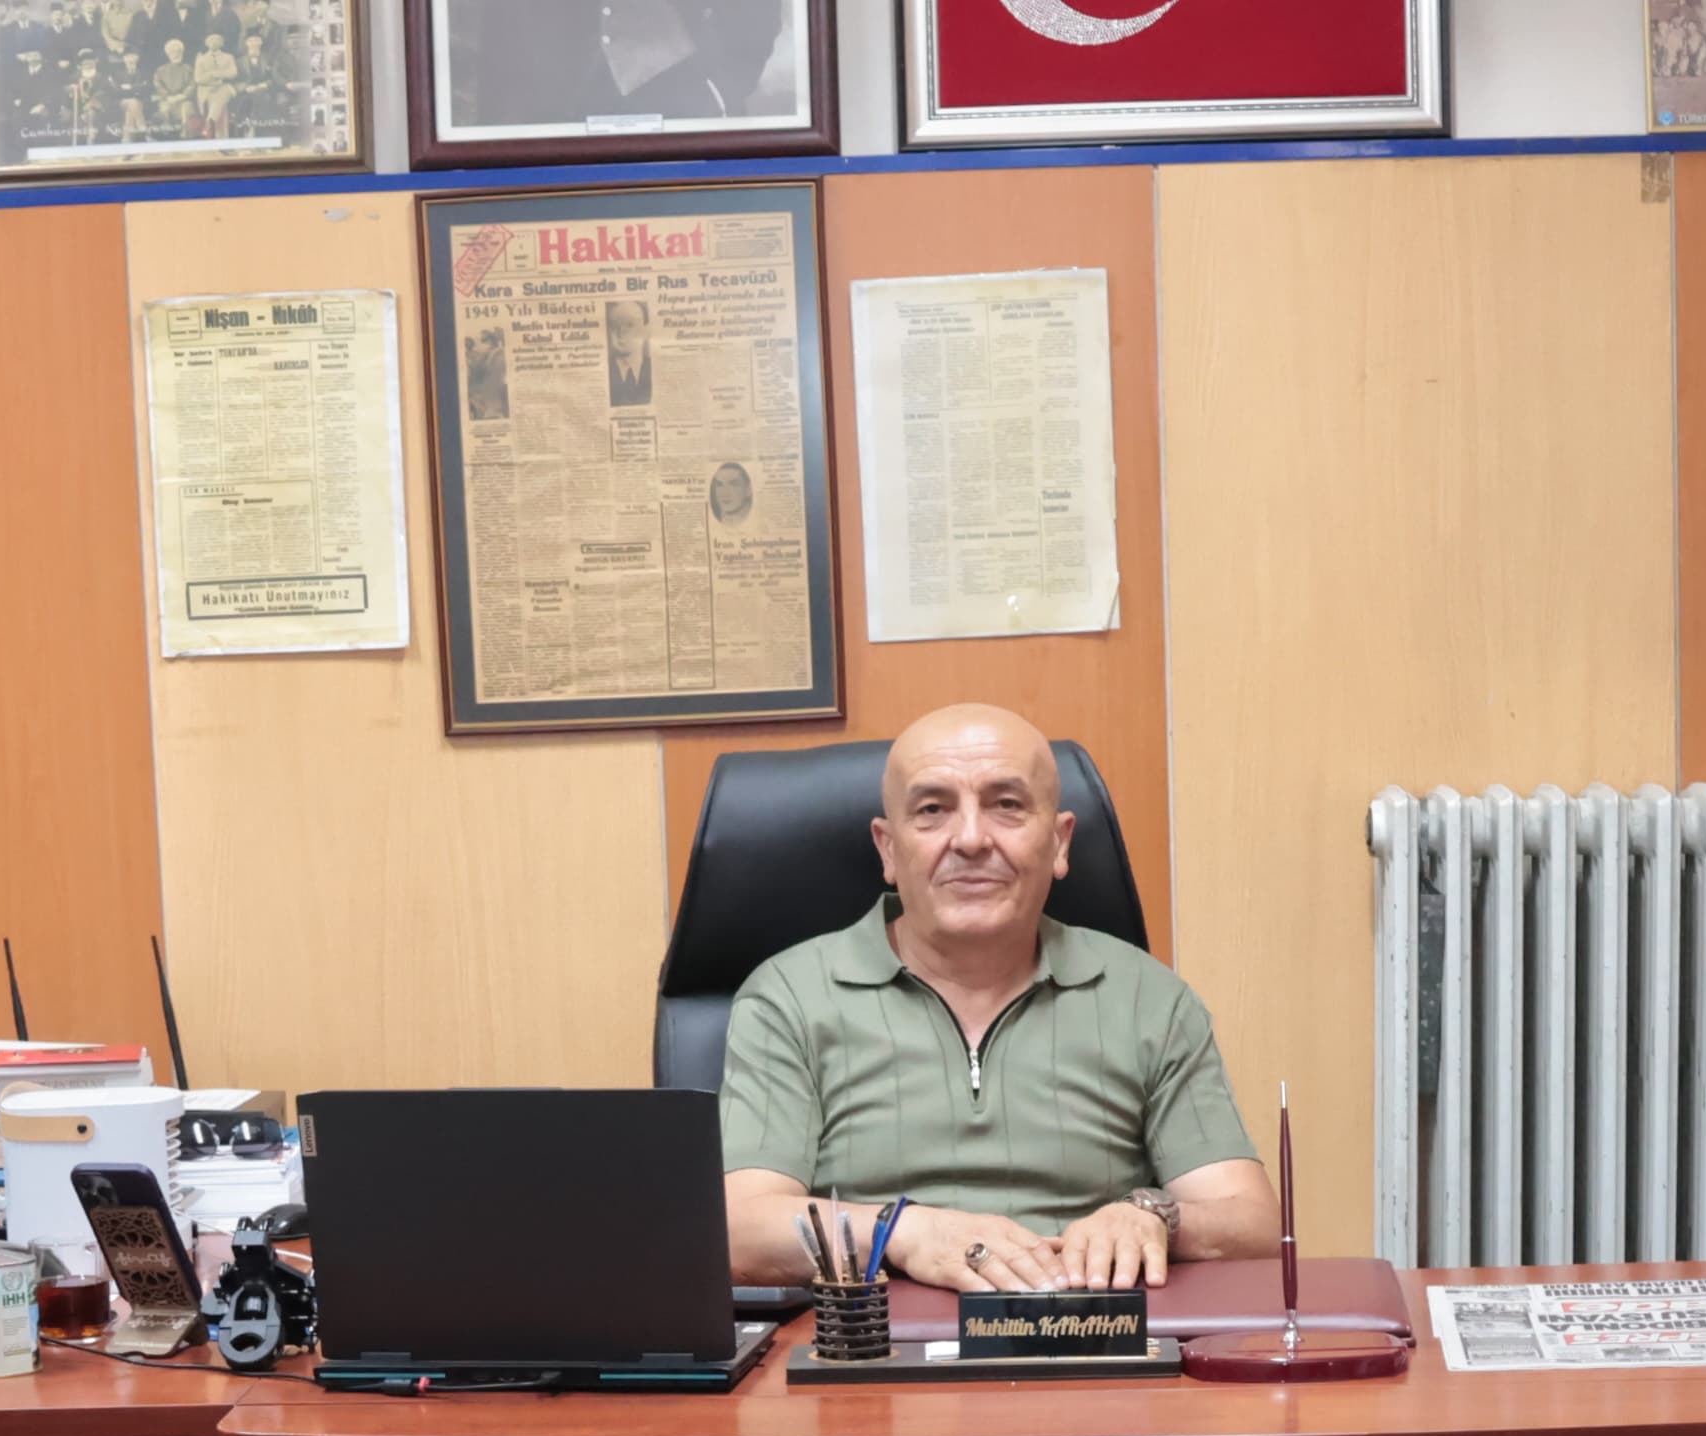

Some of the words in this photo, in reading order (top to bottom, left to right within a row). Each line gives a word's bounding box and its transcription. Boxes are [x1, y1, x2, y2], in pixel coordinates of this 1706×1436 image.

[538, 221, 705, 265] Hakikat
[474, 285, 513, 299] Kara
[523, 281, 616, 297] Sularımızda
[626, 277, 649, 291] Bir
[657, 275, 689, 289] Rus
[699, 270, 778, 287] Tecavüzü
[204, 309, 250, 330] Nişan
[464, 304, 499, 319] 1949
[505, 303, 533, 317] Yılı
[202, 592, 260, 606] Hakikatı
[267, 589, 351, 604] Unutmayınız
[304, 1117, 314, 1152] Lenovo
[965, 1317, 1037, 1337] Muhittin
[1038, 1314, 1139, 1338] KARAHAN
